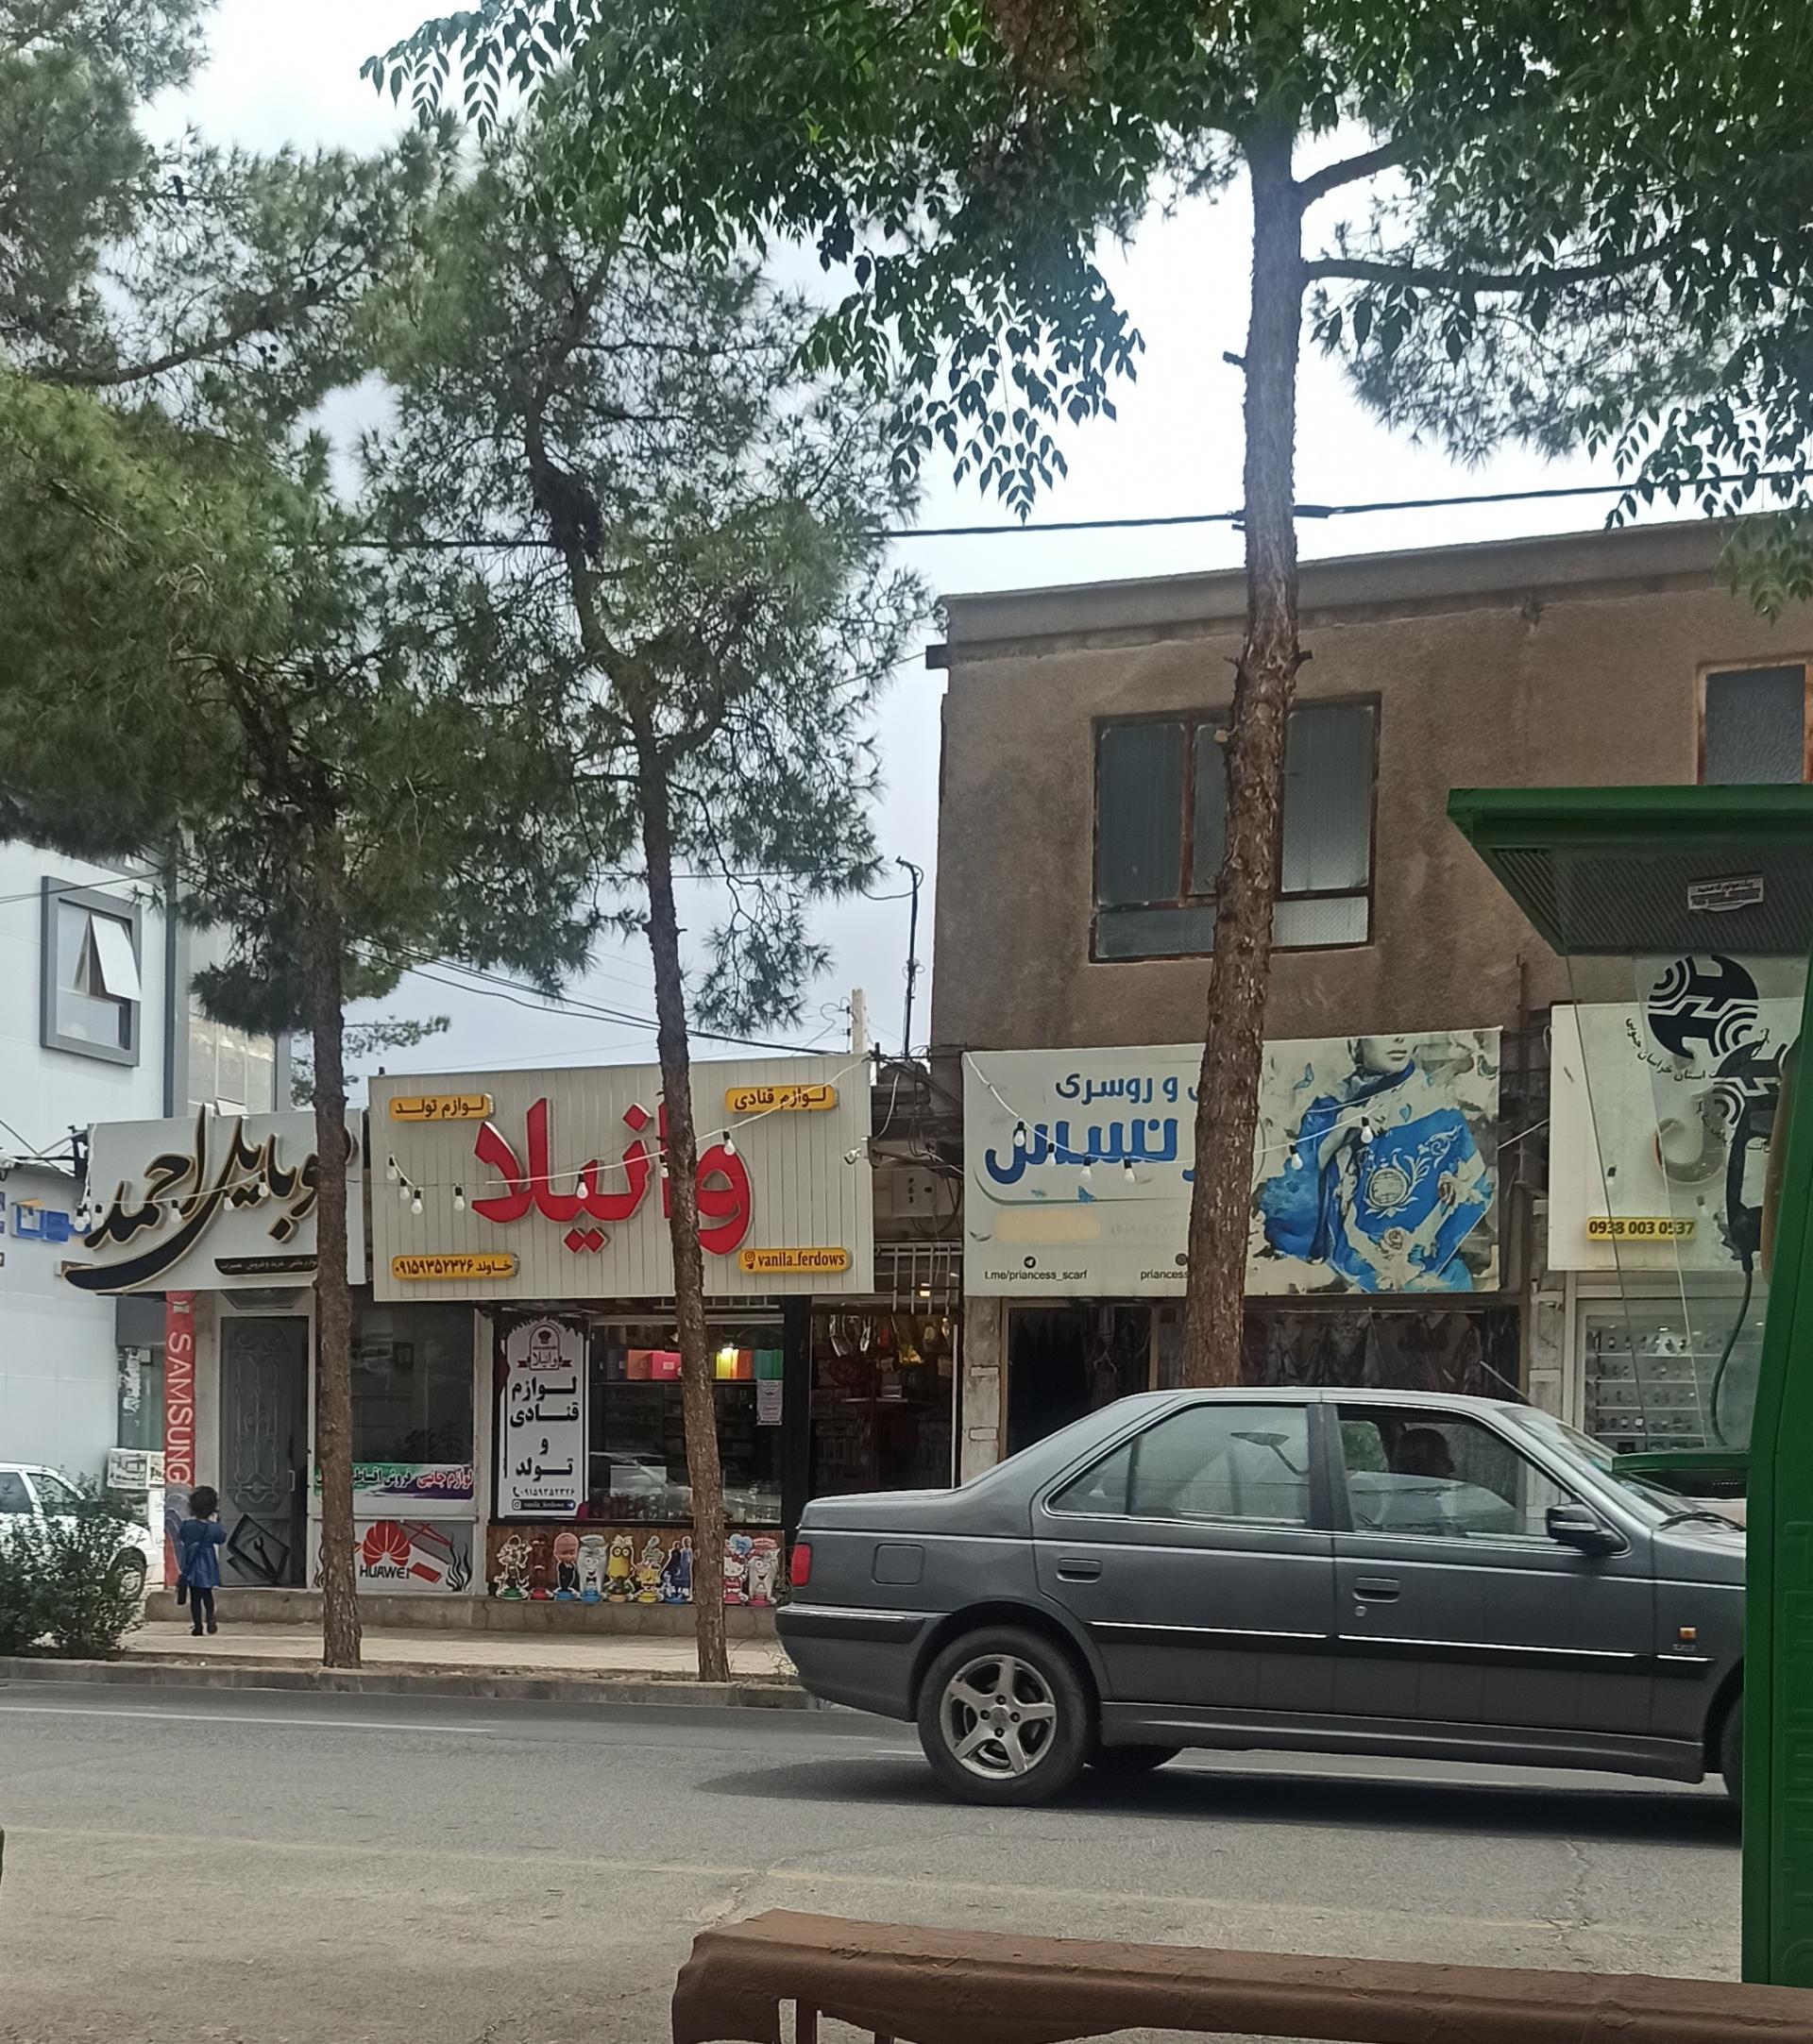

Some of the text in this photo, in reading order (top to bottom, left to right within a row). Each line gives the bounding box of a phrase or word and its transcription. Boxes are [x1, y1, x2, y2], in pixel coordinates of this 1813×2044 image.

[1637, 1050, 1672, 1073] خراسان
[1674, 1070, 1705, 1081] استان
[735, 1087, 826, 1110] لوازم قنادی
[1056, 1073, 1153, 1105] روسری
[1162, 1077, 1178, 1103] و
[395, 1096, 484, 1118] لوازم تولد
[1588, 1221, 1696, 1235] 0938 003 0537
[396, 1258, 473, 1275] ۰۹۱۵۹۳۵۲۳۲۶
[757, 1251, 845, 1267] vanila_ferdows
[512, 1376, 577, 1401] لوازم
[166, 1331, 194, 1489] SAMSUNG
[510, 1402, 580, 1428] قنادی
[539, 1438, 549, 1455] و
[383, 1469, 412, 1488] فروش
[416, 1470, 447, 1489] جانبی
[447, 1467, 473, 1490] لوازم
[516, 1457, 573, 1481] تولد
[359, 1564, 410, 1579] HUAWEI
